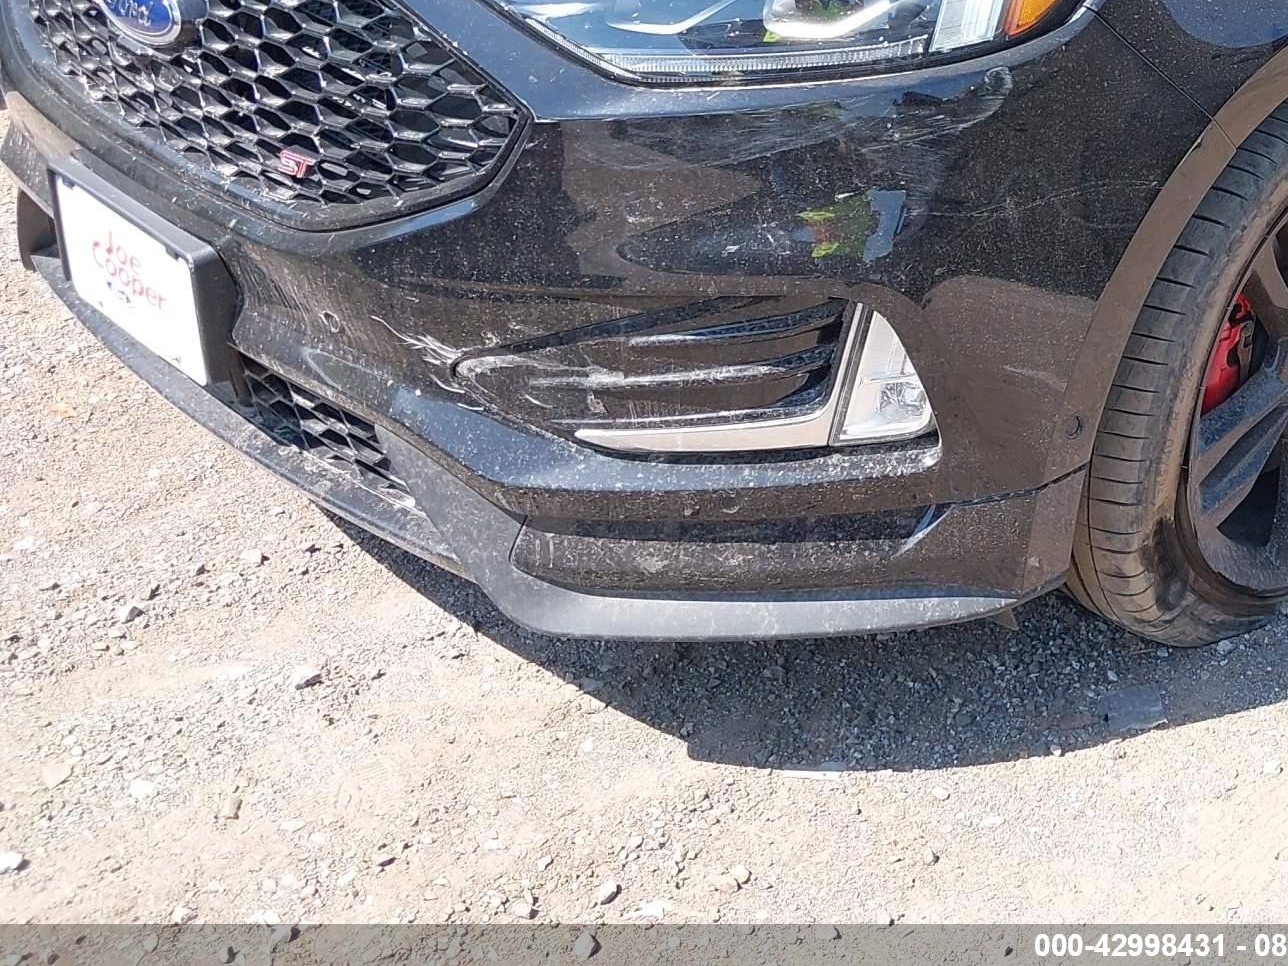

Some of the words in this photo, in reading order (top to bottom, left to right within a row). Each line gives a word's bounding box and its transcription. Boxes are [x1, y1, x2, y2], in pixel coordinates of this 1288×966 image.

[279, 148, 316, 178] ST
[107, 230, 142, 275] Joe
[92, 240, 168, 311] Cooper
